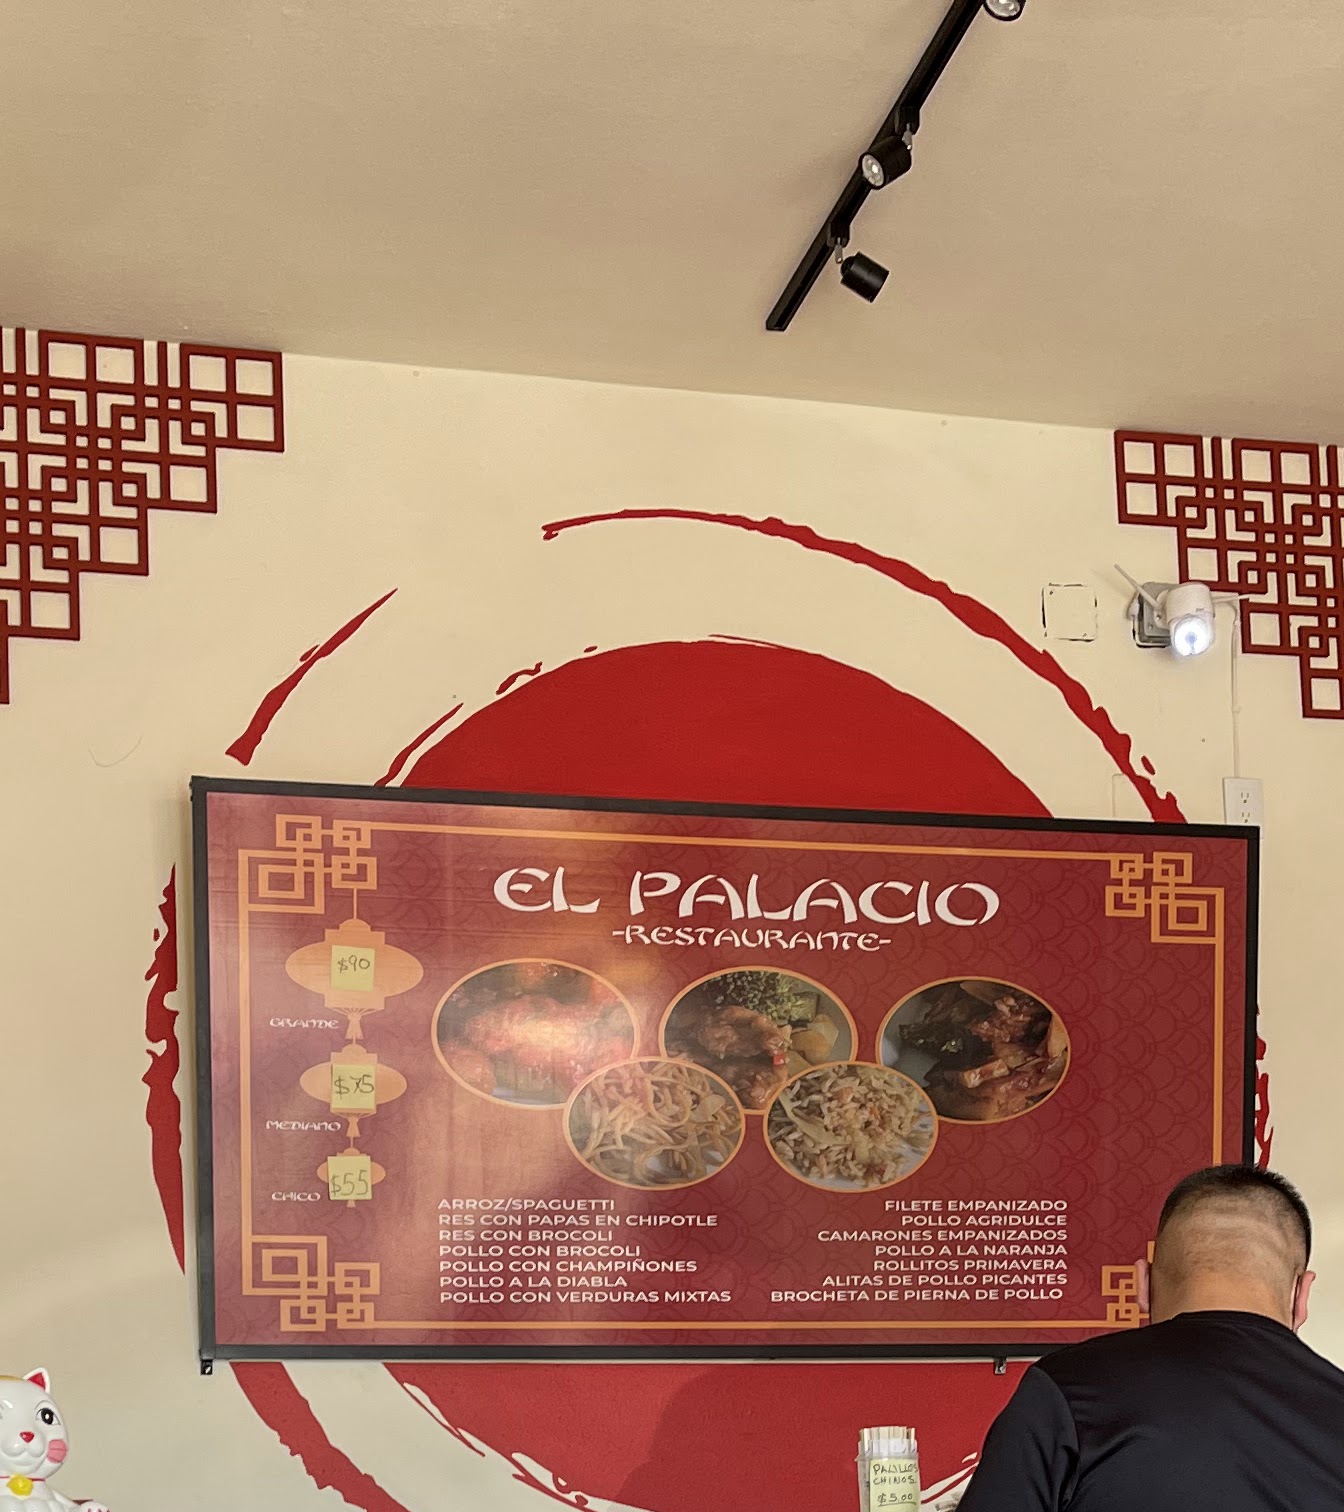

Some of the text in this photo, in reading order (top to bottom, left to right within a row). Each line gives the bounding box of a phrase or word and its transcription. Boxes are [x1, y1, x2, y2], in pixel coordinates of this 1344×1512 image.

[492, 866, 1000, 927] EL PALACIO
[336, 954, 371, 974] $90
[269, 1017, 340, 1030] GRANDE
[333, 1074, 375, 1100] $75
[265, 1120, 342, 1132] MEDIANO
[329, 1169, 370, 1197] $55
[271, 1191, 321, 1202] CHICO
[437, 1198, 615, 1211] ARROZ/SPAGUETTI
[885, 1200, 1068, 1212] FILETE EMPANIZADO
[439, 1214, 718, 1227] RES CON PAPAS EN CHIPOTLE
[902, 1215, 1068, 1226] POLLO AGRIDULCE
[439, 1229, 613, 1242] RES CON BROCOLI
[817, 1230, 1068, 1242] CAMARONES EMPANIZADOS
[439, 1245, 640, 1257] POLLO CON BROCOLI
[875, 1245, 1068, 1256] POLLO A LA NARANJA
[439, 1258, 698, 1273] POLLO CON CHAMPIÑONES
[873, 1259, 1068, 1272] ROLLITOS PRIMAVERA
[440, 1276, 628, 1288] POLLO A LA DIABLA
[822, 1274, 1068, 1287] ALITAS DE POLLO PICANTES
[440, 1291, 731, 1303] POLLO CON VERDURAS MIXTAS
[771, 1289, 1063, 1302] BROCHETA DE PIERNA DE POLLO
[873, 1475, 917, 1485] CHINOS
